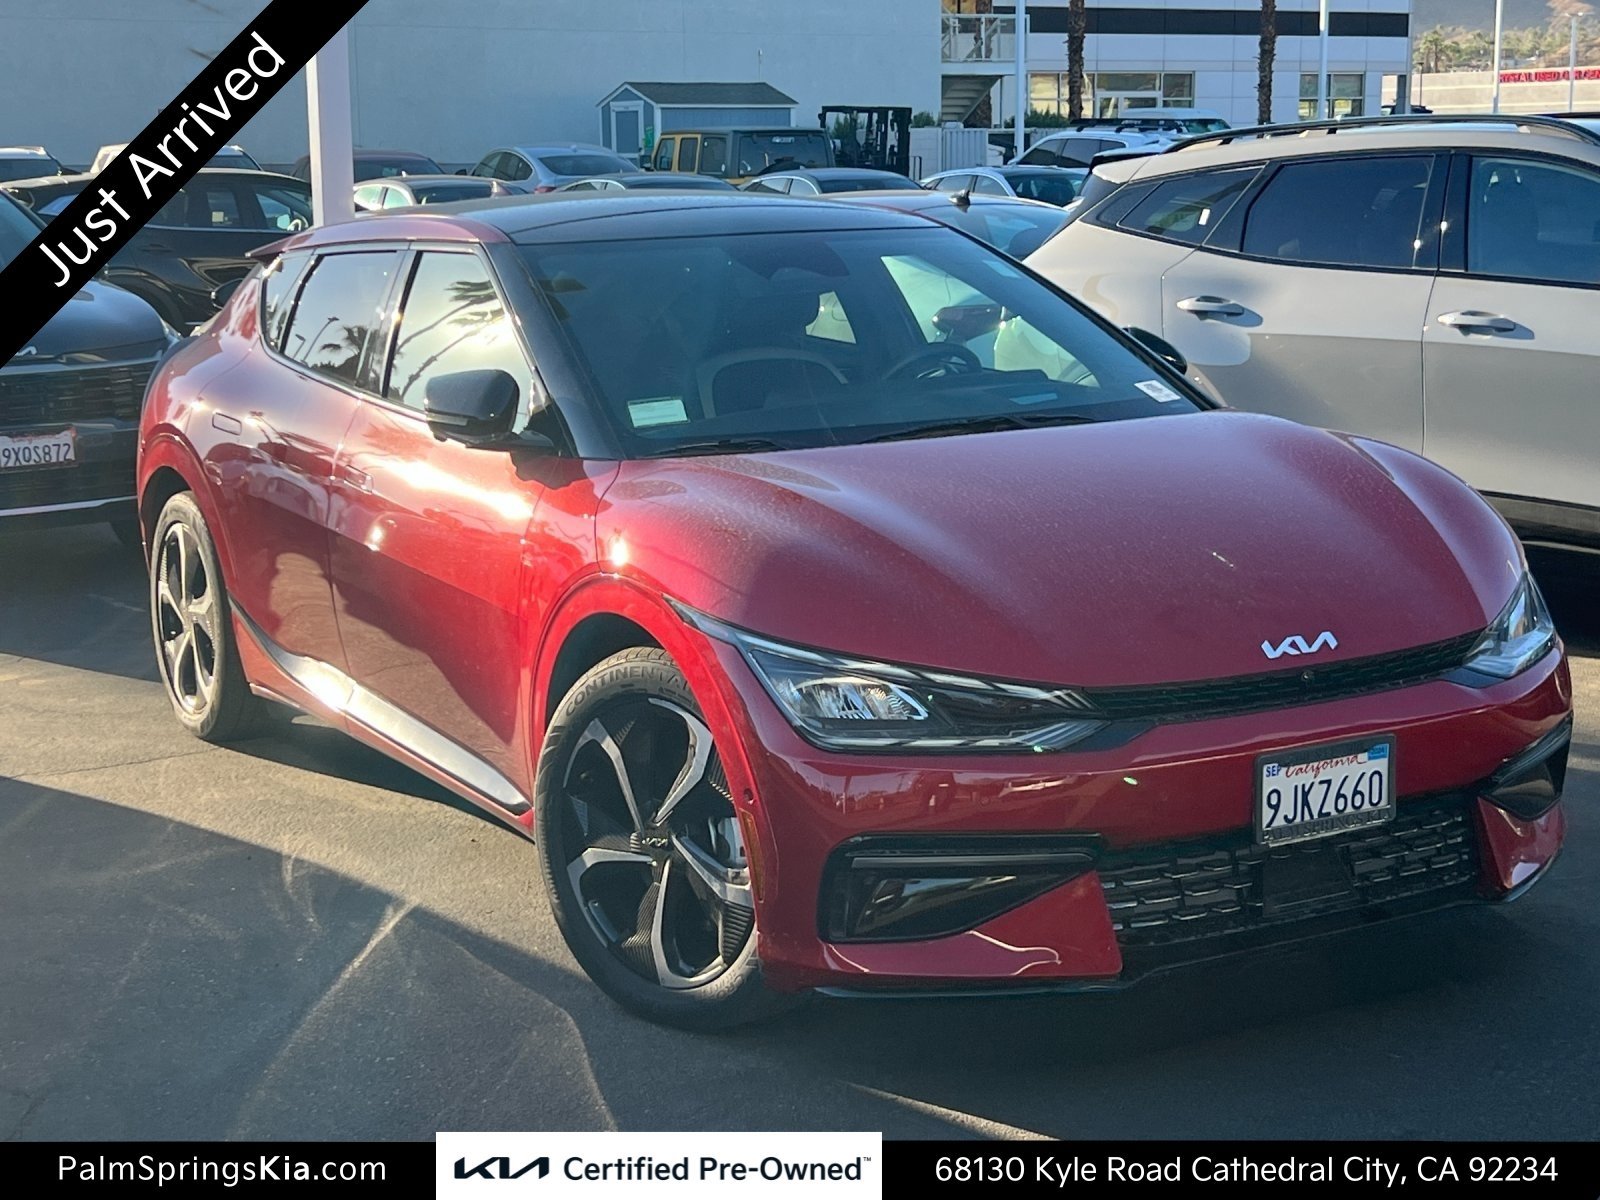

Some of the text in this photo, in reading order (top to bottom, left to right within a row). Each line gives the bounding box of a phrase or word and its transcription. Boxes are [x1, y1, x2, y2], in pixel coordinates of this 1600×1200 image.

[1260, 631, 1338, 659] KIA
[1265, 765, 1281, 778] SEP
[1285, 754, 1368, 778] California
[1264, 769, 1383, 829] 9JKZ660
